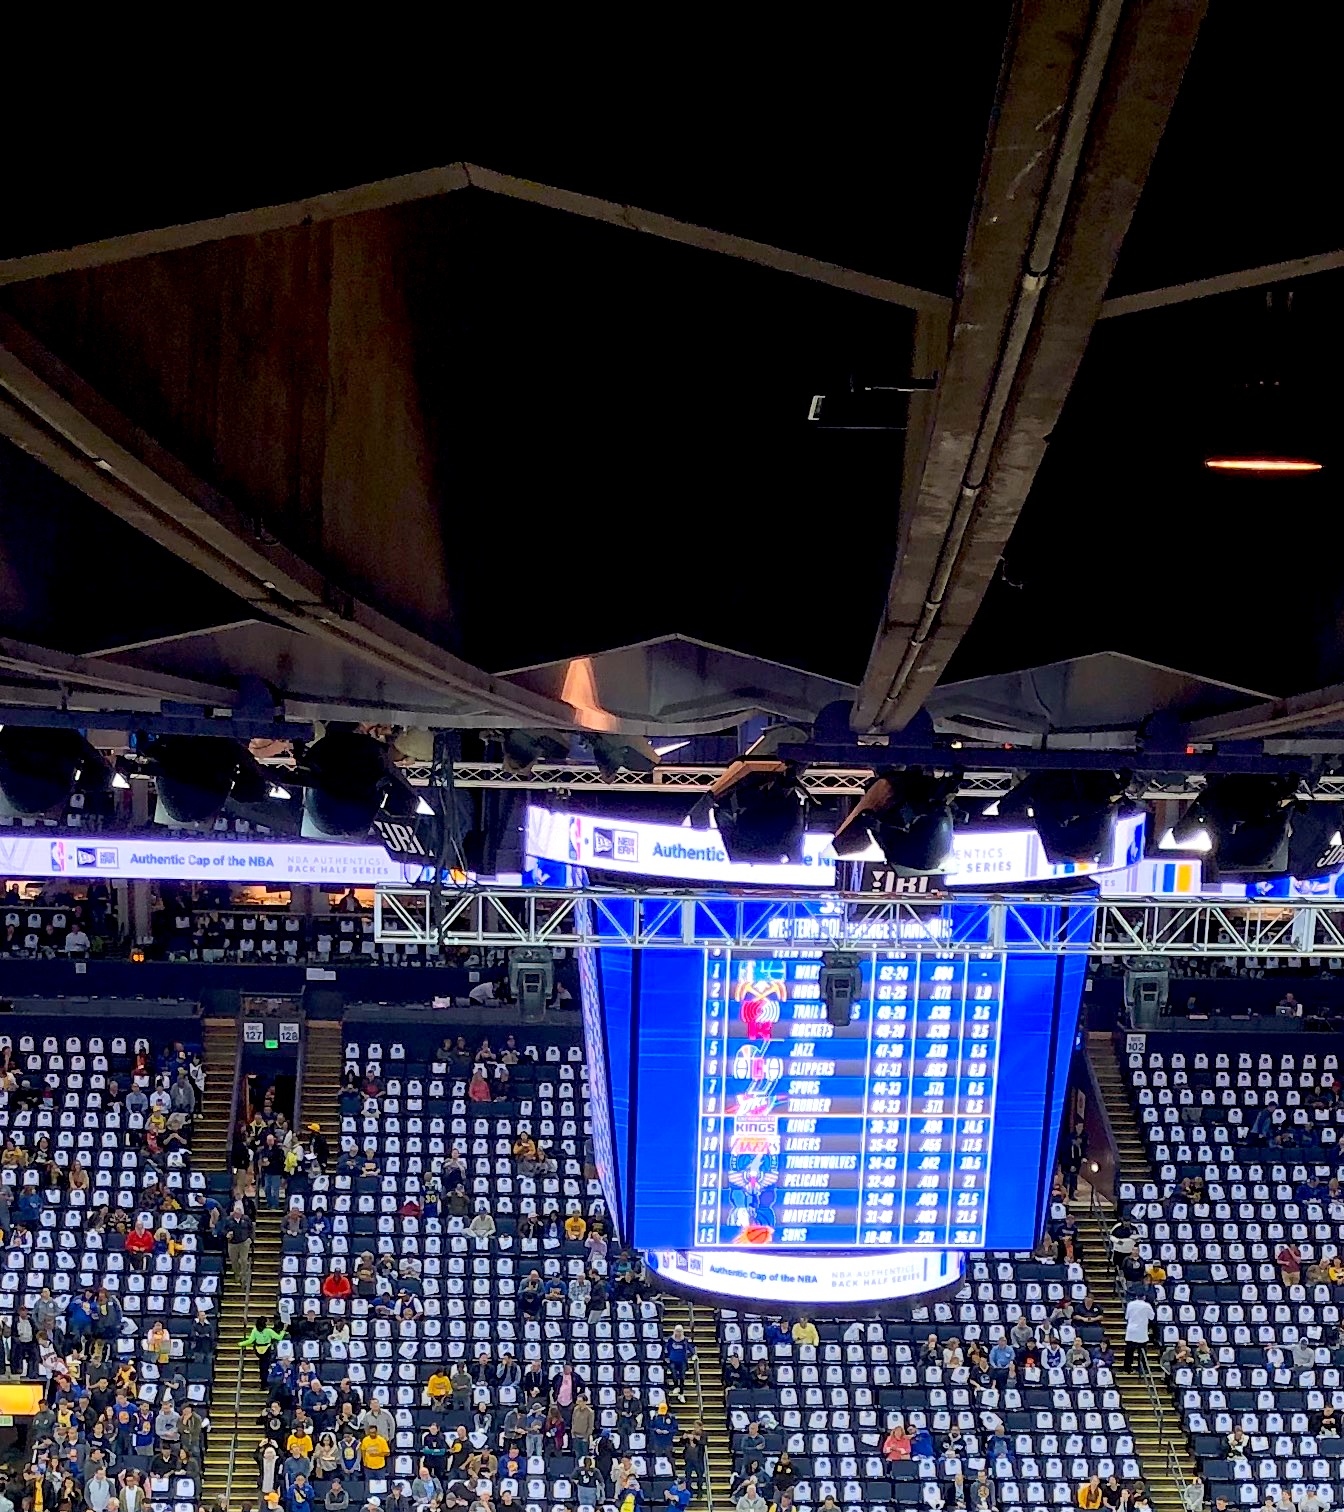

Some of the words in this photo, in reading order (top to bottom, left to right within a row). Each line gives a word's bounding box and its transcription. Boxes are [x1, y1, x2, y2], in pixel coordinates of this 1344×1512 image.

[652, 841, 725, 863] Authentic
[129, 853, 185, 866] Authentic
[187, 854, 211, 868] Cap
[212, 855, 226, 867] of
[227, 855, 246, 867] the
[248, 856, 275, 868] NBA
[966, 860, 1012, 873] SERIES
[287, 865, 316, 873] BACK
[319, 865, 348, 874] HALF
[351, 866, 389, 875] SERIES
[793, 1004, 819, 1019] TRAIL
[245, 1031, 262, 1040] 127
[280, 1032, 298, 1041] 128
[789, 1023, 834, 1037] ROCKETS
[789, 1043, 815, 1057] JAZZ
[1127, 1042, 1145, 1051] 102
[788, 1060, 836, 1076] CLIPPERS
[788, 1080, 821, 1095] SPURS
[787, 1098, 832, 1113] THUNDER
[735, 1123, 776, 1133] KINGS
[784, 1137, 821, 1151] LAKERS
[702, 1154, 716, 1169] 11
[785, 1155, 857, 1169] TIMBERWOLVES
[701, 1173, 717, 1187] 12
[782, 1173, 830, 1187] PELICANS
[701, 1191, 716, 1206] 13
[782, 1191, 830, 1206] GRIZZLIES
[700, 1208, 715, 1223] 14
[781, 1209, 836, 1223] MAVERICKS
[699, 1229, 714, 1243] 15
[781, 1228, 807, 1242] SUNS
[709, 1264, 748, 1279] Authentic
[750, 1269, 767, 1283] Cap
[768, 1271, 779, 1282] of
[780, 1273, 796, 1283] the
[797, 1274, 818, 1284] NBA
